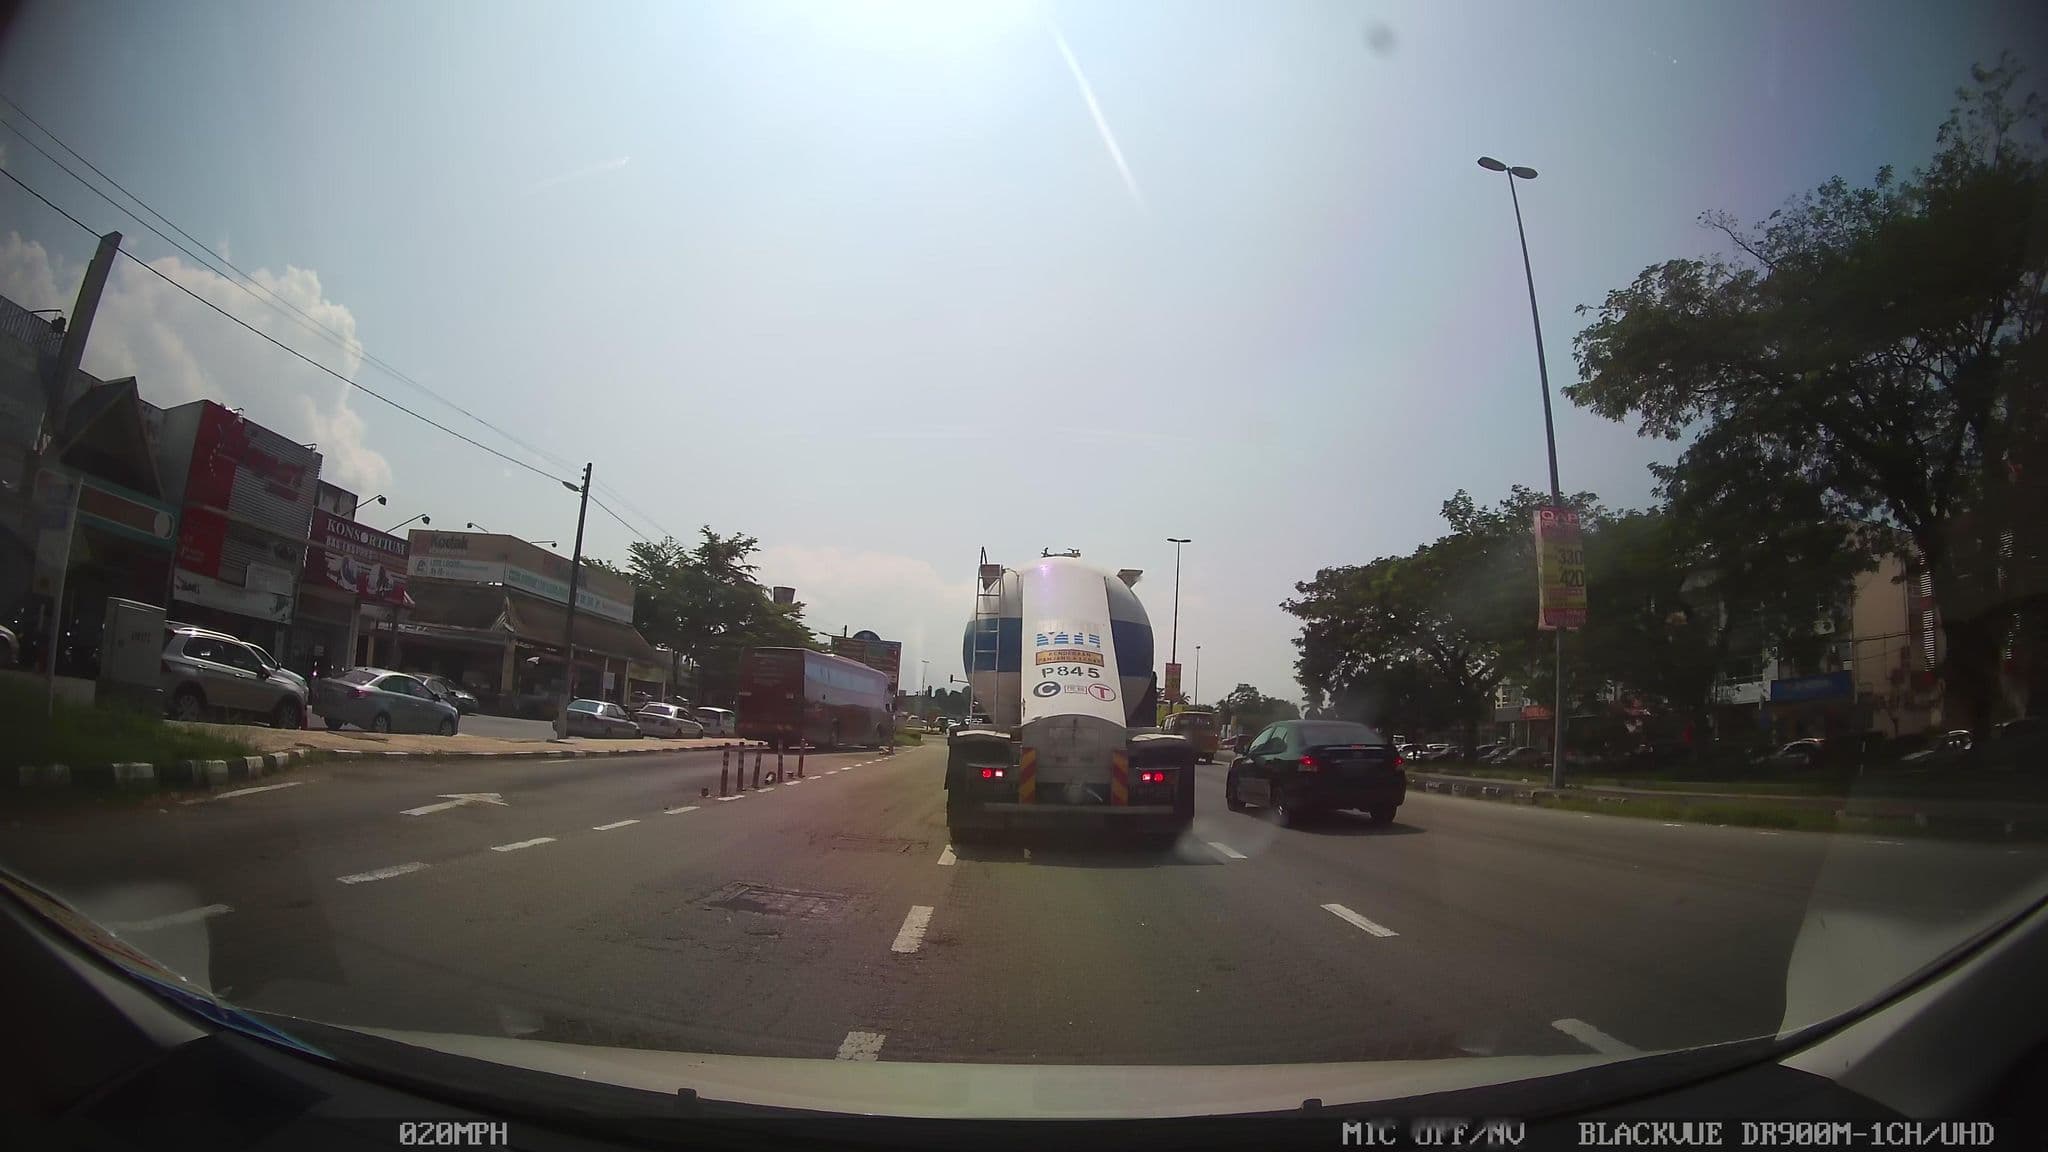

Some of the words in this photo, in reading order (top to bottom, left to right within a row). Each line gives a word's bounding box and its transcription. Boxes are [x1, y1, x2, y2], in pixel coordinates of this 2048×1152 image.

[1558, 550, 1583, 566] 330
[1560, 570, 1584, 587] 420
[1042, 666, 1100, 678] P845
